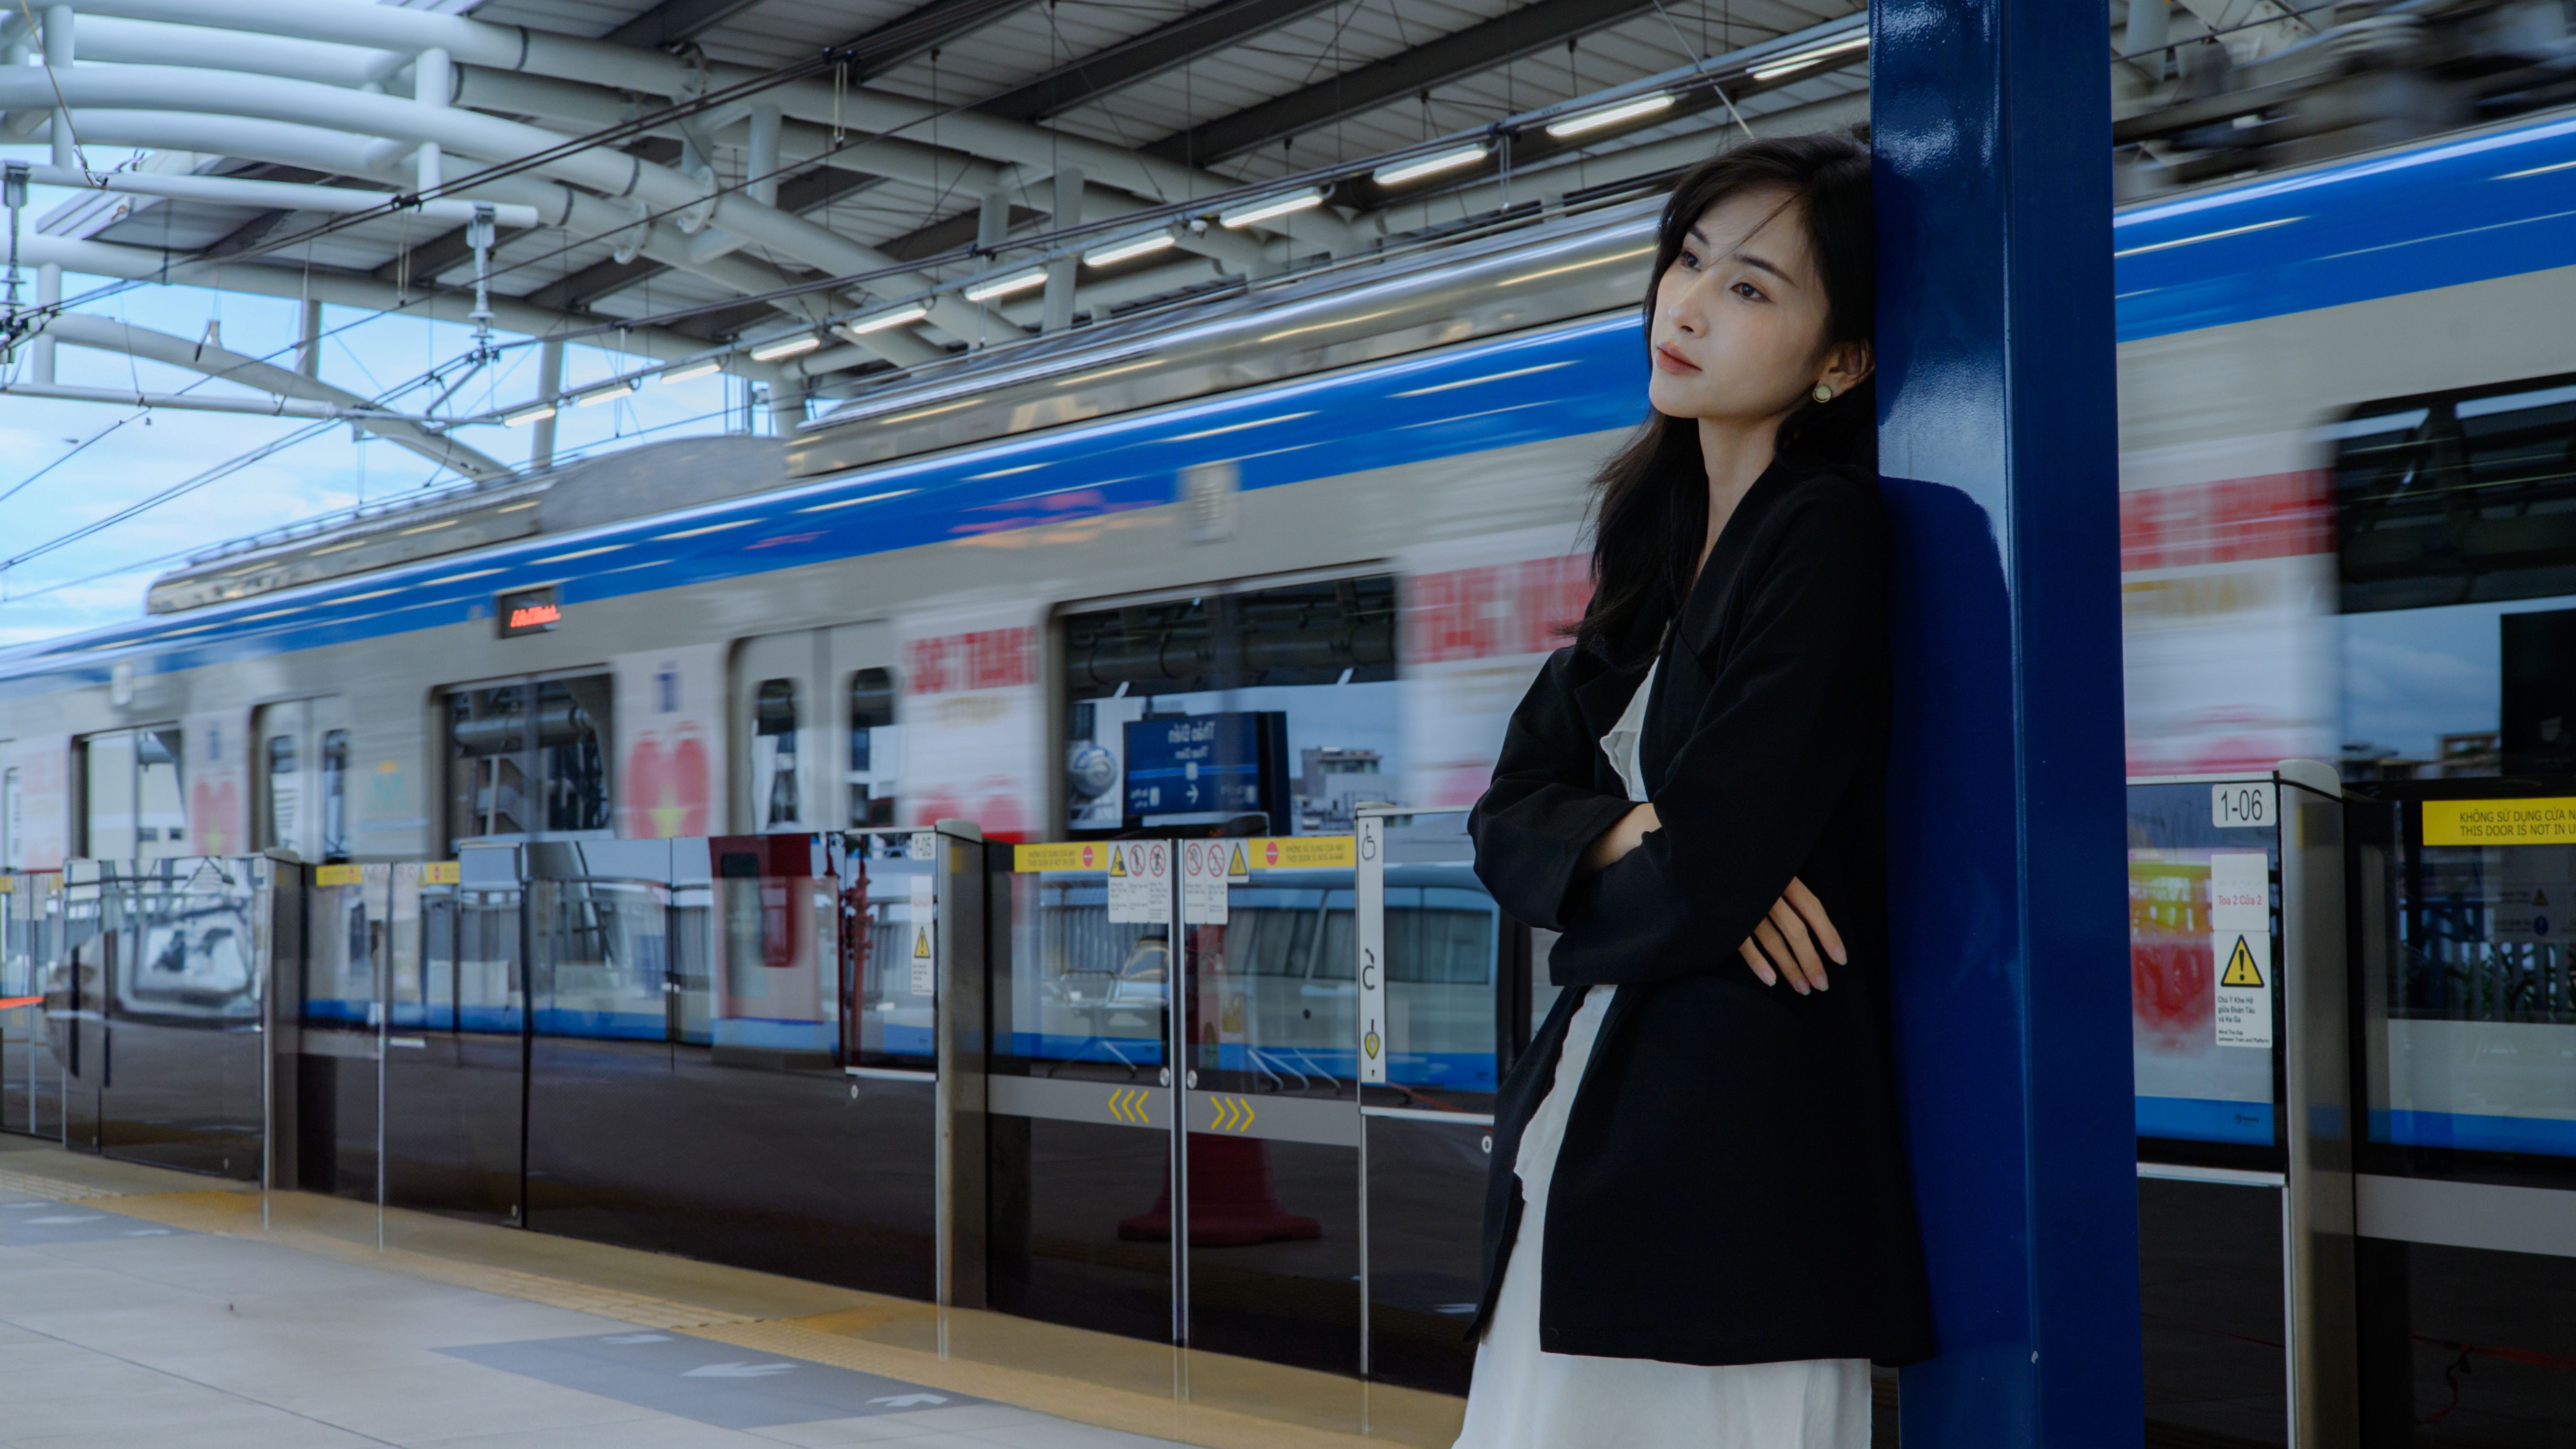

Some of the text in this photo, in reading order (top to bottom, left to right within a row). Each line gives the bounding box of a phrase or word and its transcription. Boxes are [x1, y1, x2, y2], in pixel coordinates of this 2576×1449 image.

[2221, 789, 2263, 822] 1-06
[2459, 808, 2494, 823] KHÔNG
[2497, 808, 2510, 822] SỬ
[2514, 811, 2542, 823] DỤNG
[2545, 806, 2565, 821] CỬA
[2460, 823, 2576, 836] THIS DOOR IS NOT IN U
[2218, 894, 2262, 905] Toa 2 Cửa 2
